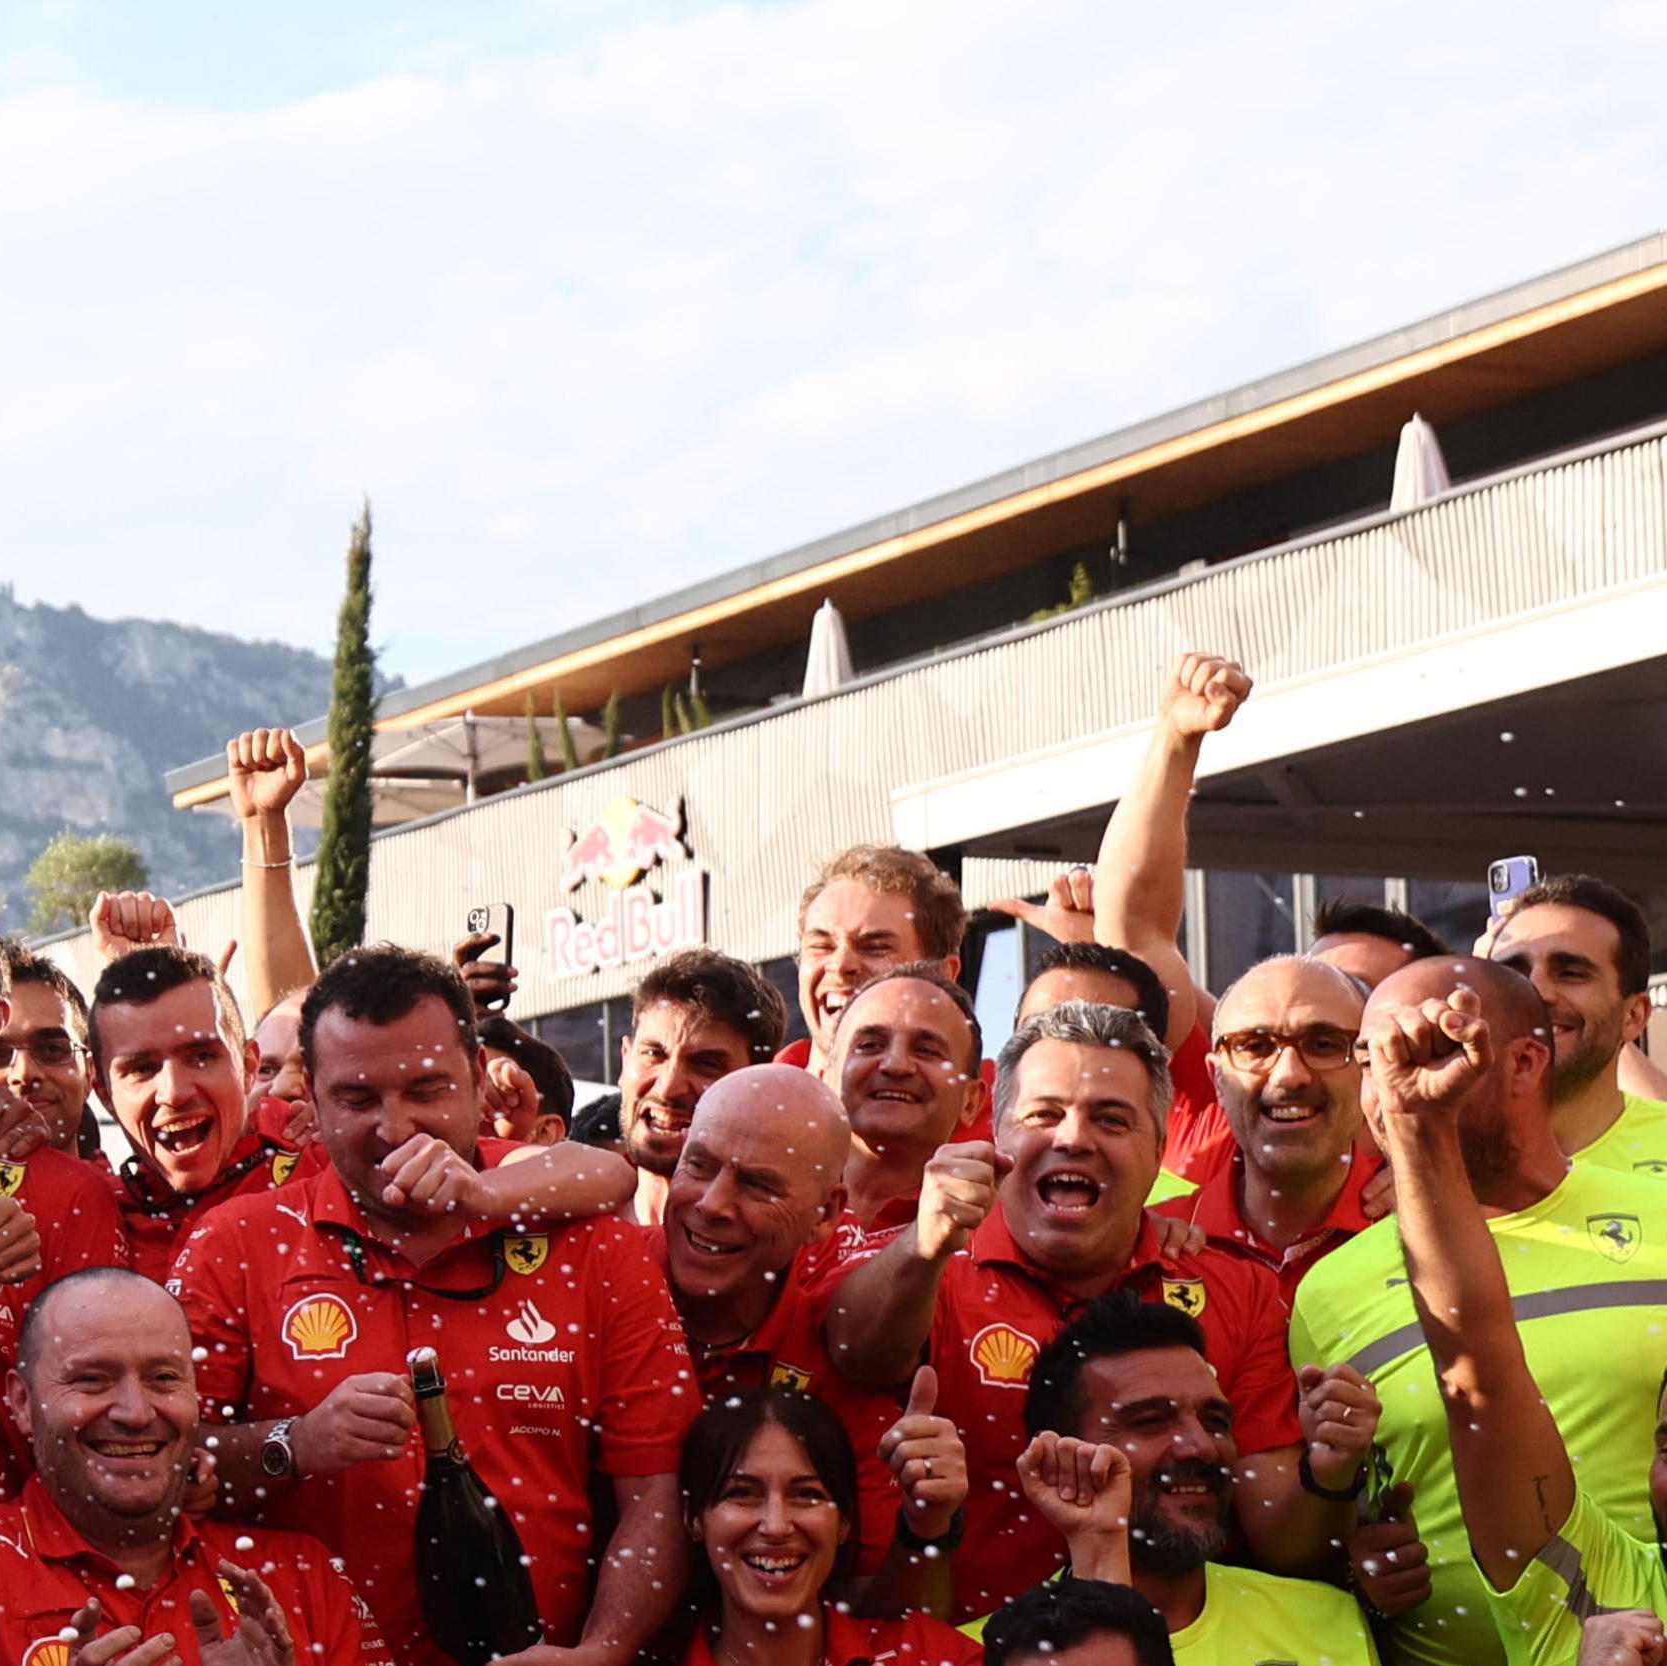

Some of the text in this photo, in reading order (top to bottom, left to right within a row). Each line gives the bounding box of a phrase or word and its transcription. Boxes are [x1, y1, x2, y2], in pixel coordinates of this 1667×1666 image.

[549, 875, 701, 972] Red Bull
[488, 1345, 575, 1363] Santander
